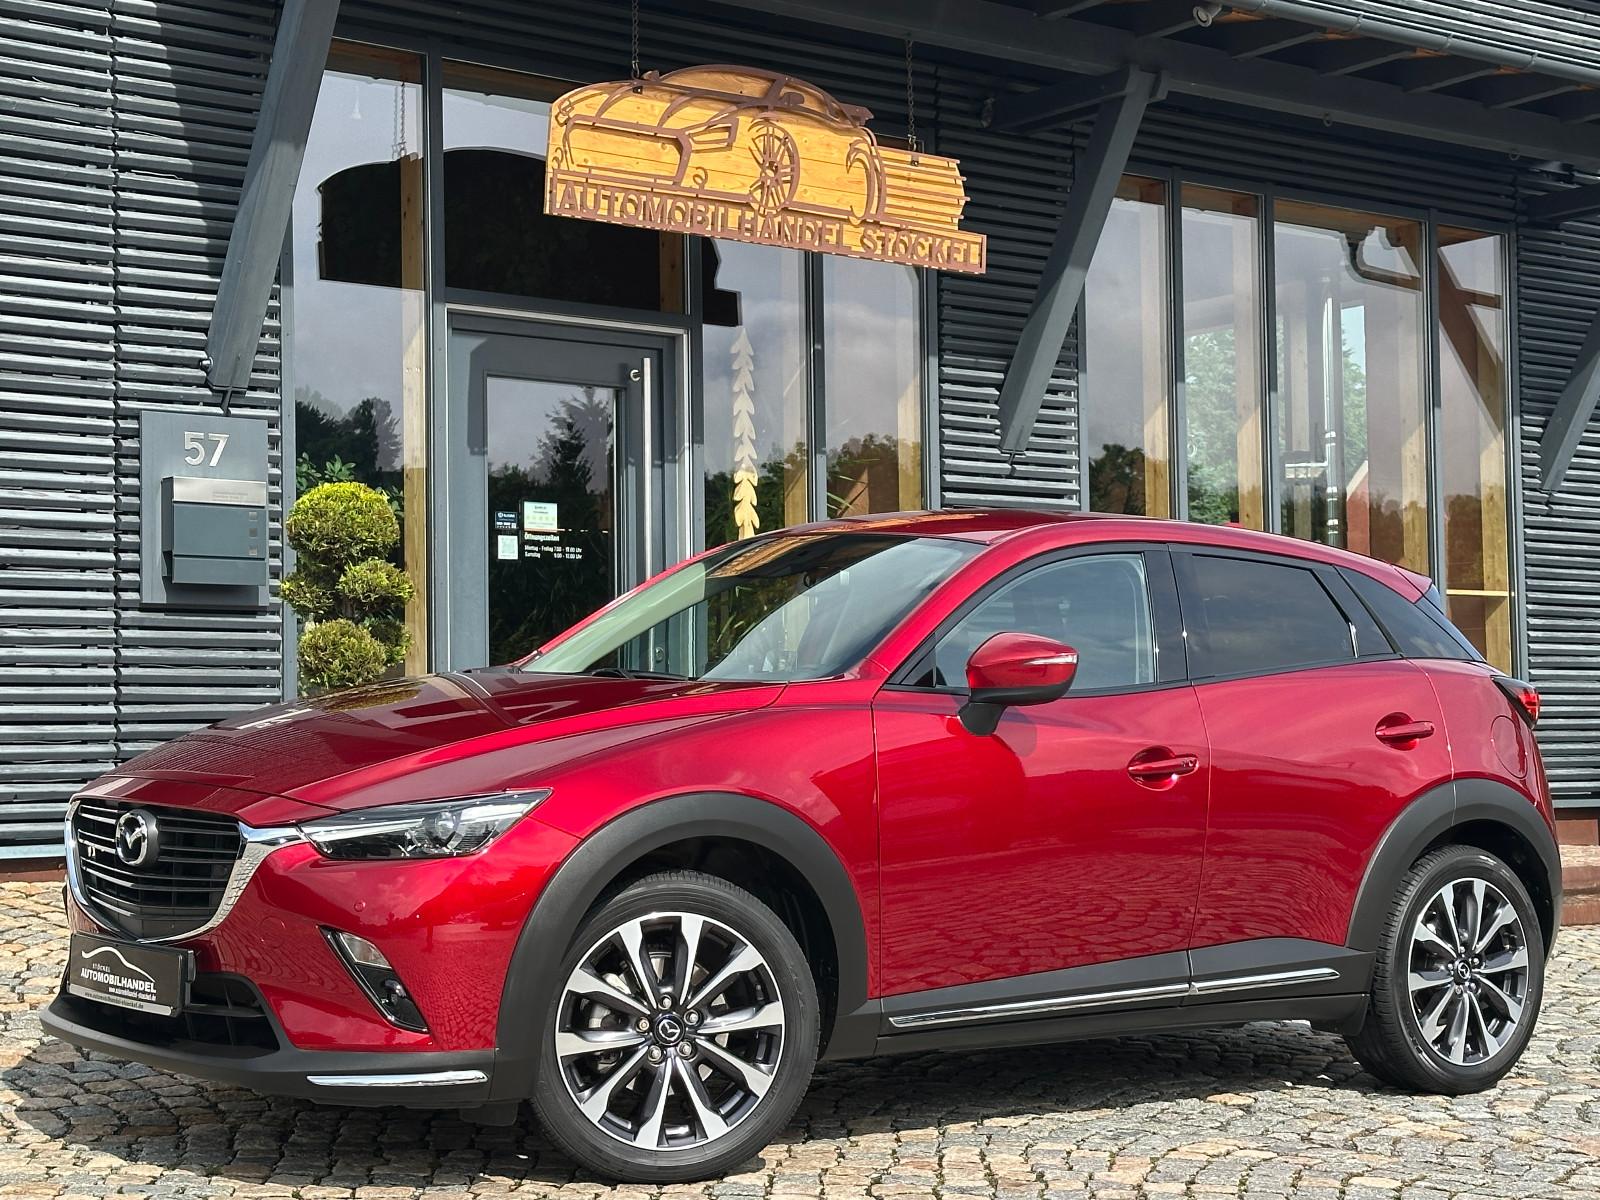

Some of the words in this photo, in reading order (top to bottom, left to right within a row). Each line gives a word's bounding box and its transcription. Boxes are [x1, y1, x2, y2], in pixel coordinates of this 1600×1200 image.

[558, 182, 852, 250] AUTOMOBILHANDEL
[184, 431, 230, 467] 57
[81, 968, 156, 993] AUTOMOBILHANDEL
